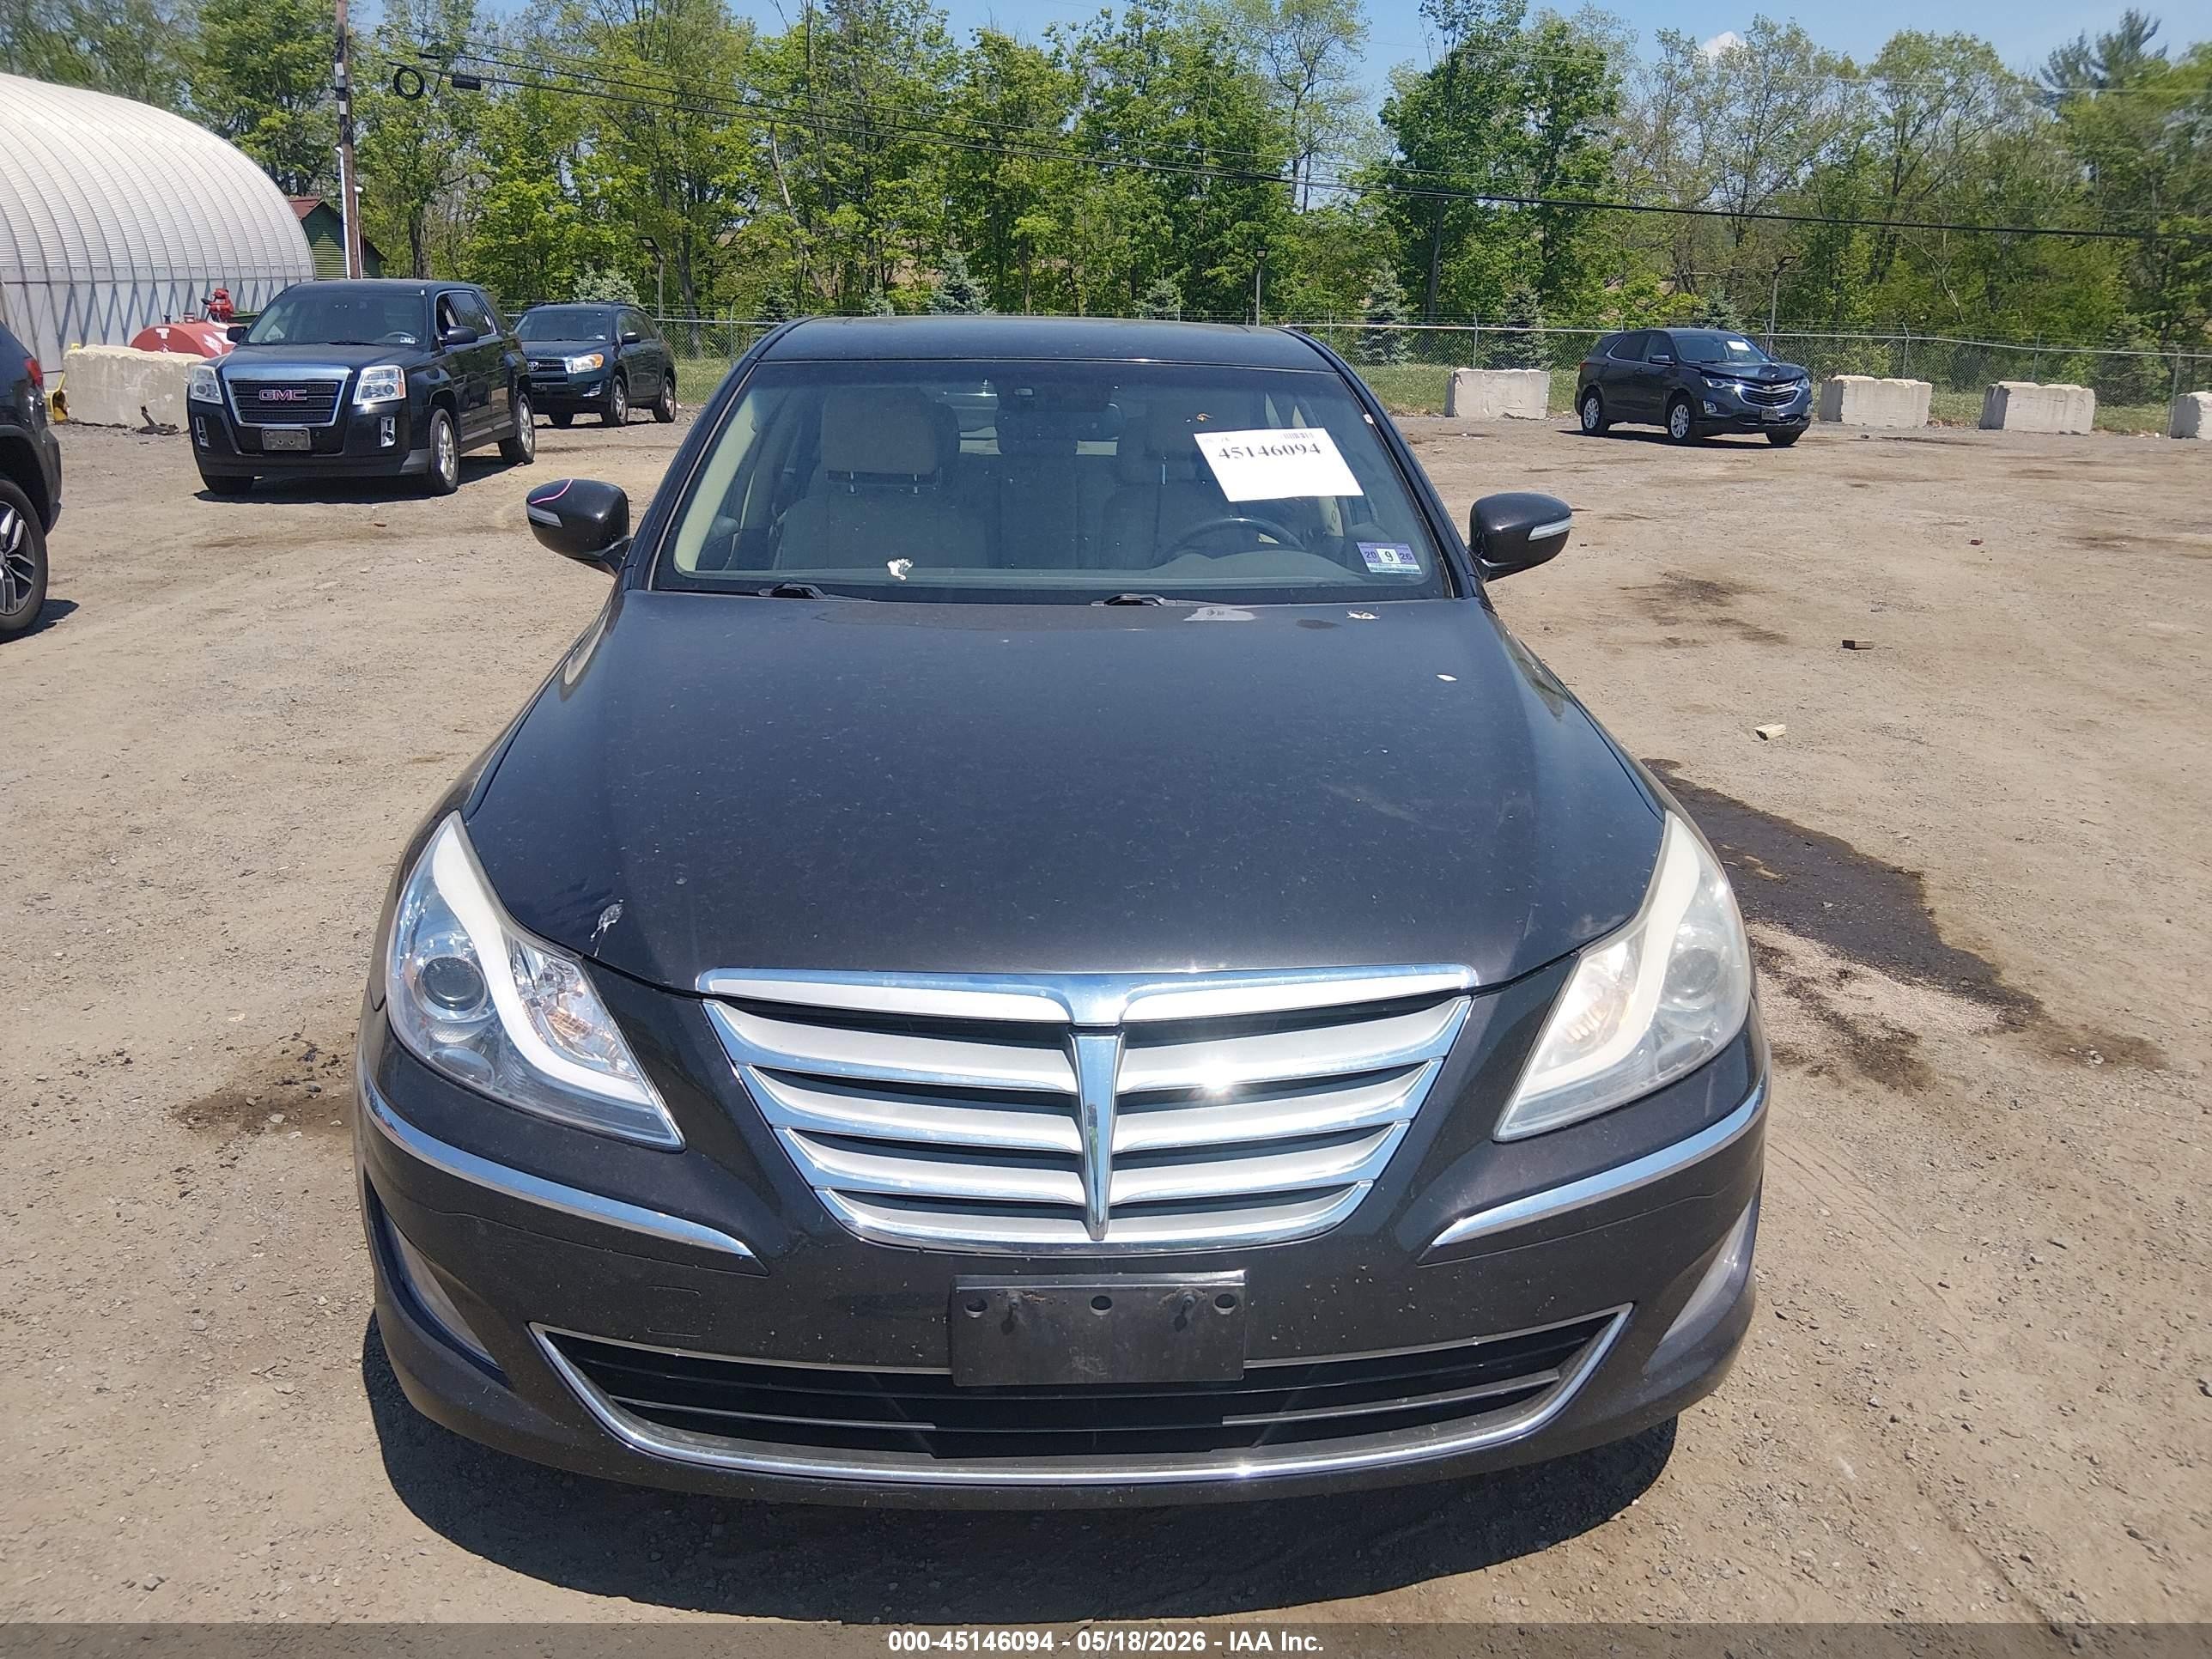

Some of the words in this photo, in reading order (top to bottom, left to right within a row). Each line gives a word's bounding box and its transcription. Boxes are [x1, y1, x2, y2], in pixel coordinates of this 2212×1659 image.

[259, 389, 307, 401] GMC
[1218, 443, 1321, 459] 45146094
[1384, 550, 1394, 562] 9
